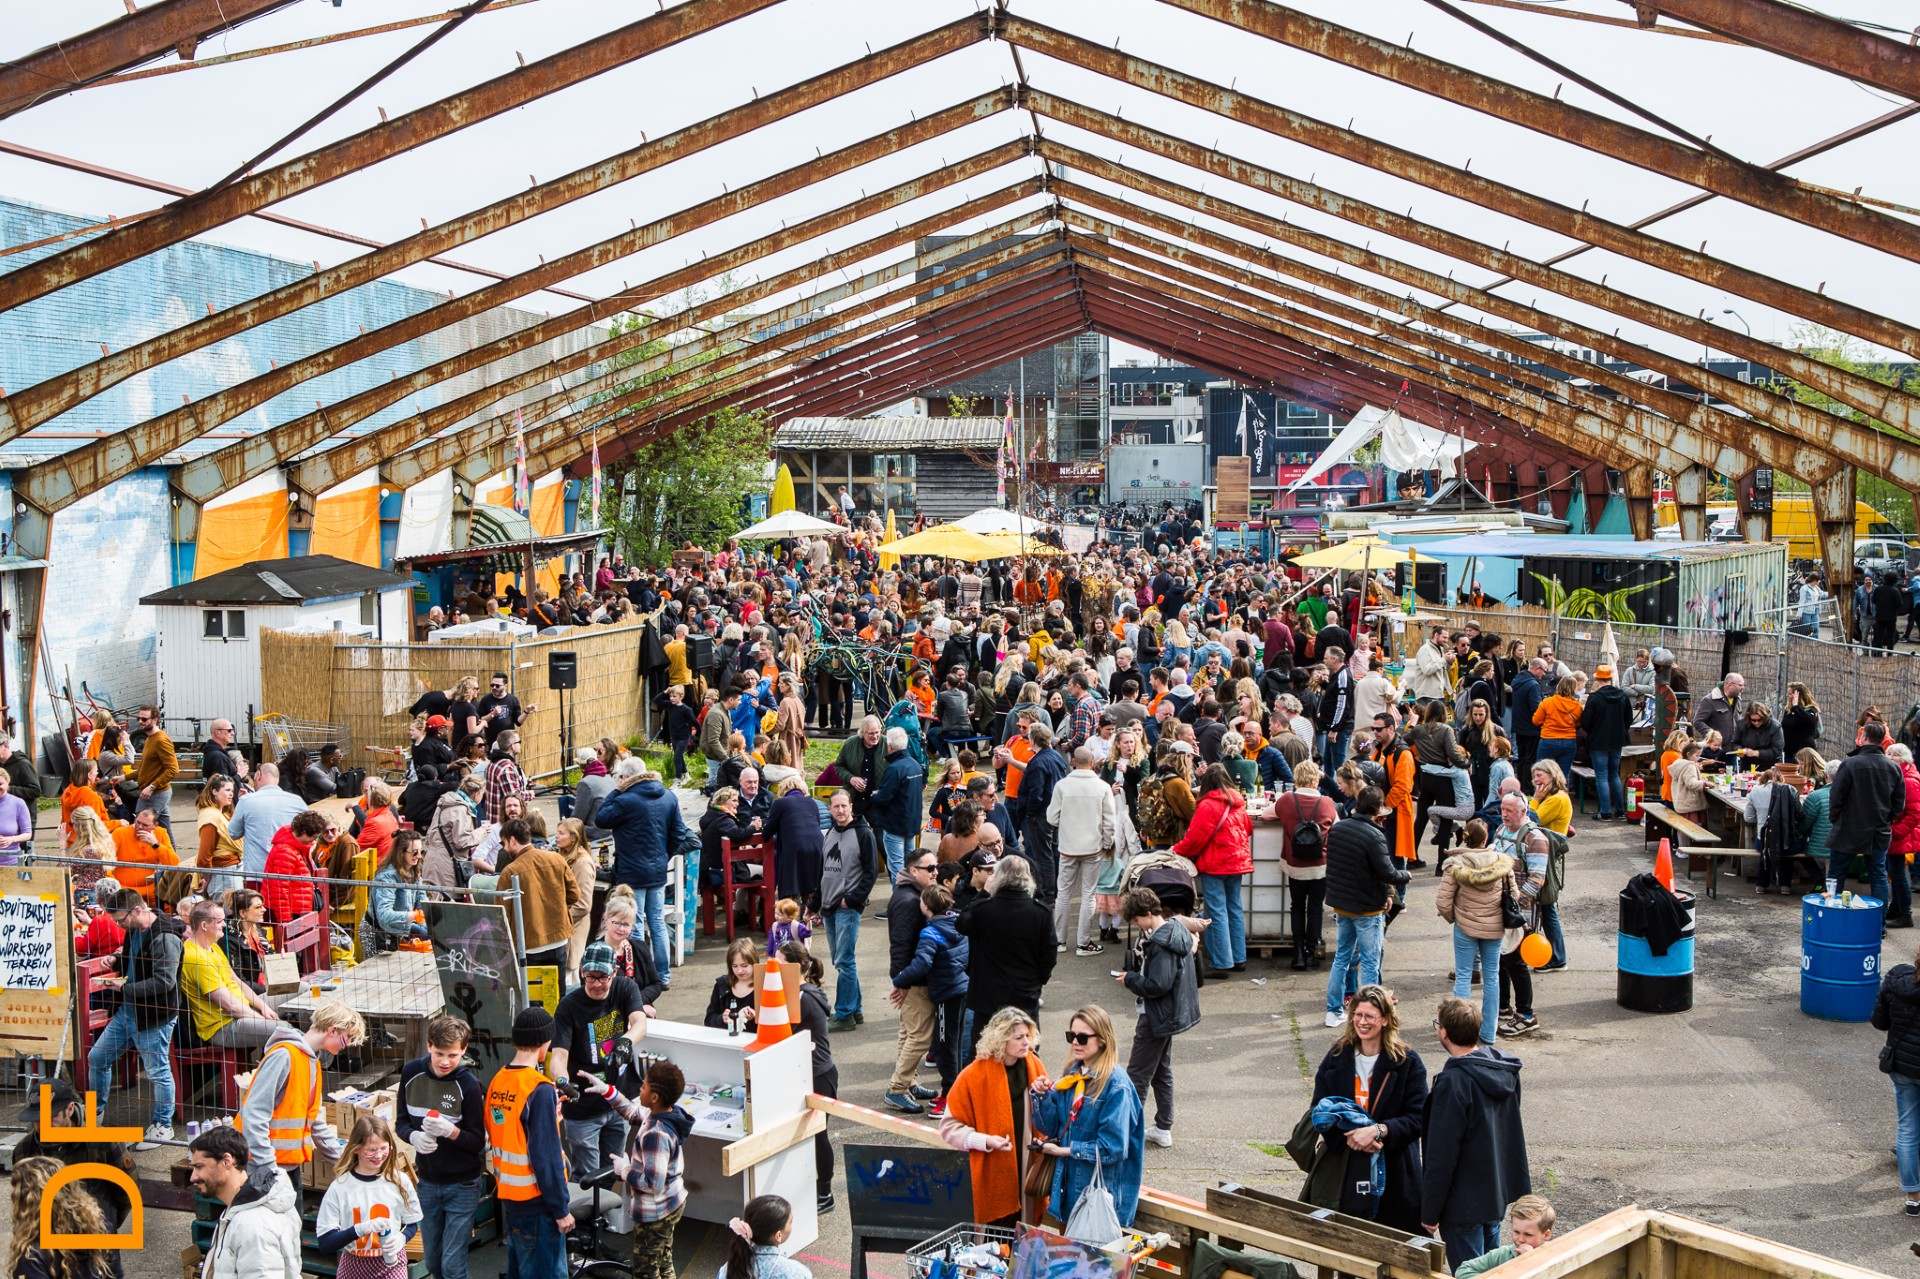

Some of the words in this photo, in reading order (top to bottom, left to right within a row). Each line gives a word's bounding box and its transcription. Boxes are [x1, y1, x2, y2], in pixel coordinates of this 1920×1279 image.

[2, 924, 16, 941] OP
[19, 925, 43, 939] HET
[0, 942, 52, 958] WORKSHOP
[3, 959, 52, 971] TERREIN
[7, 1003, 52, 1014] JOEPLA
